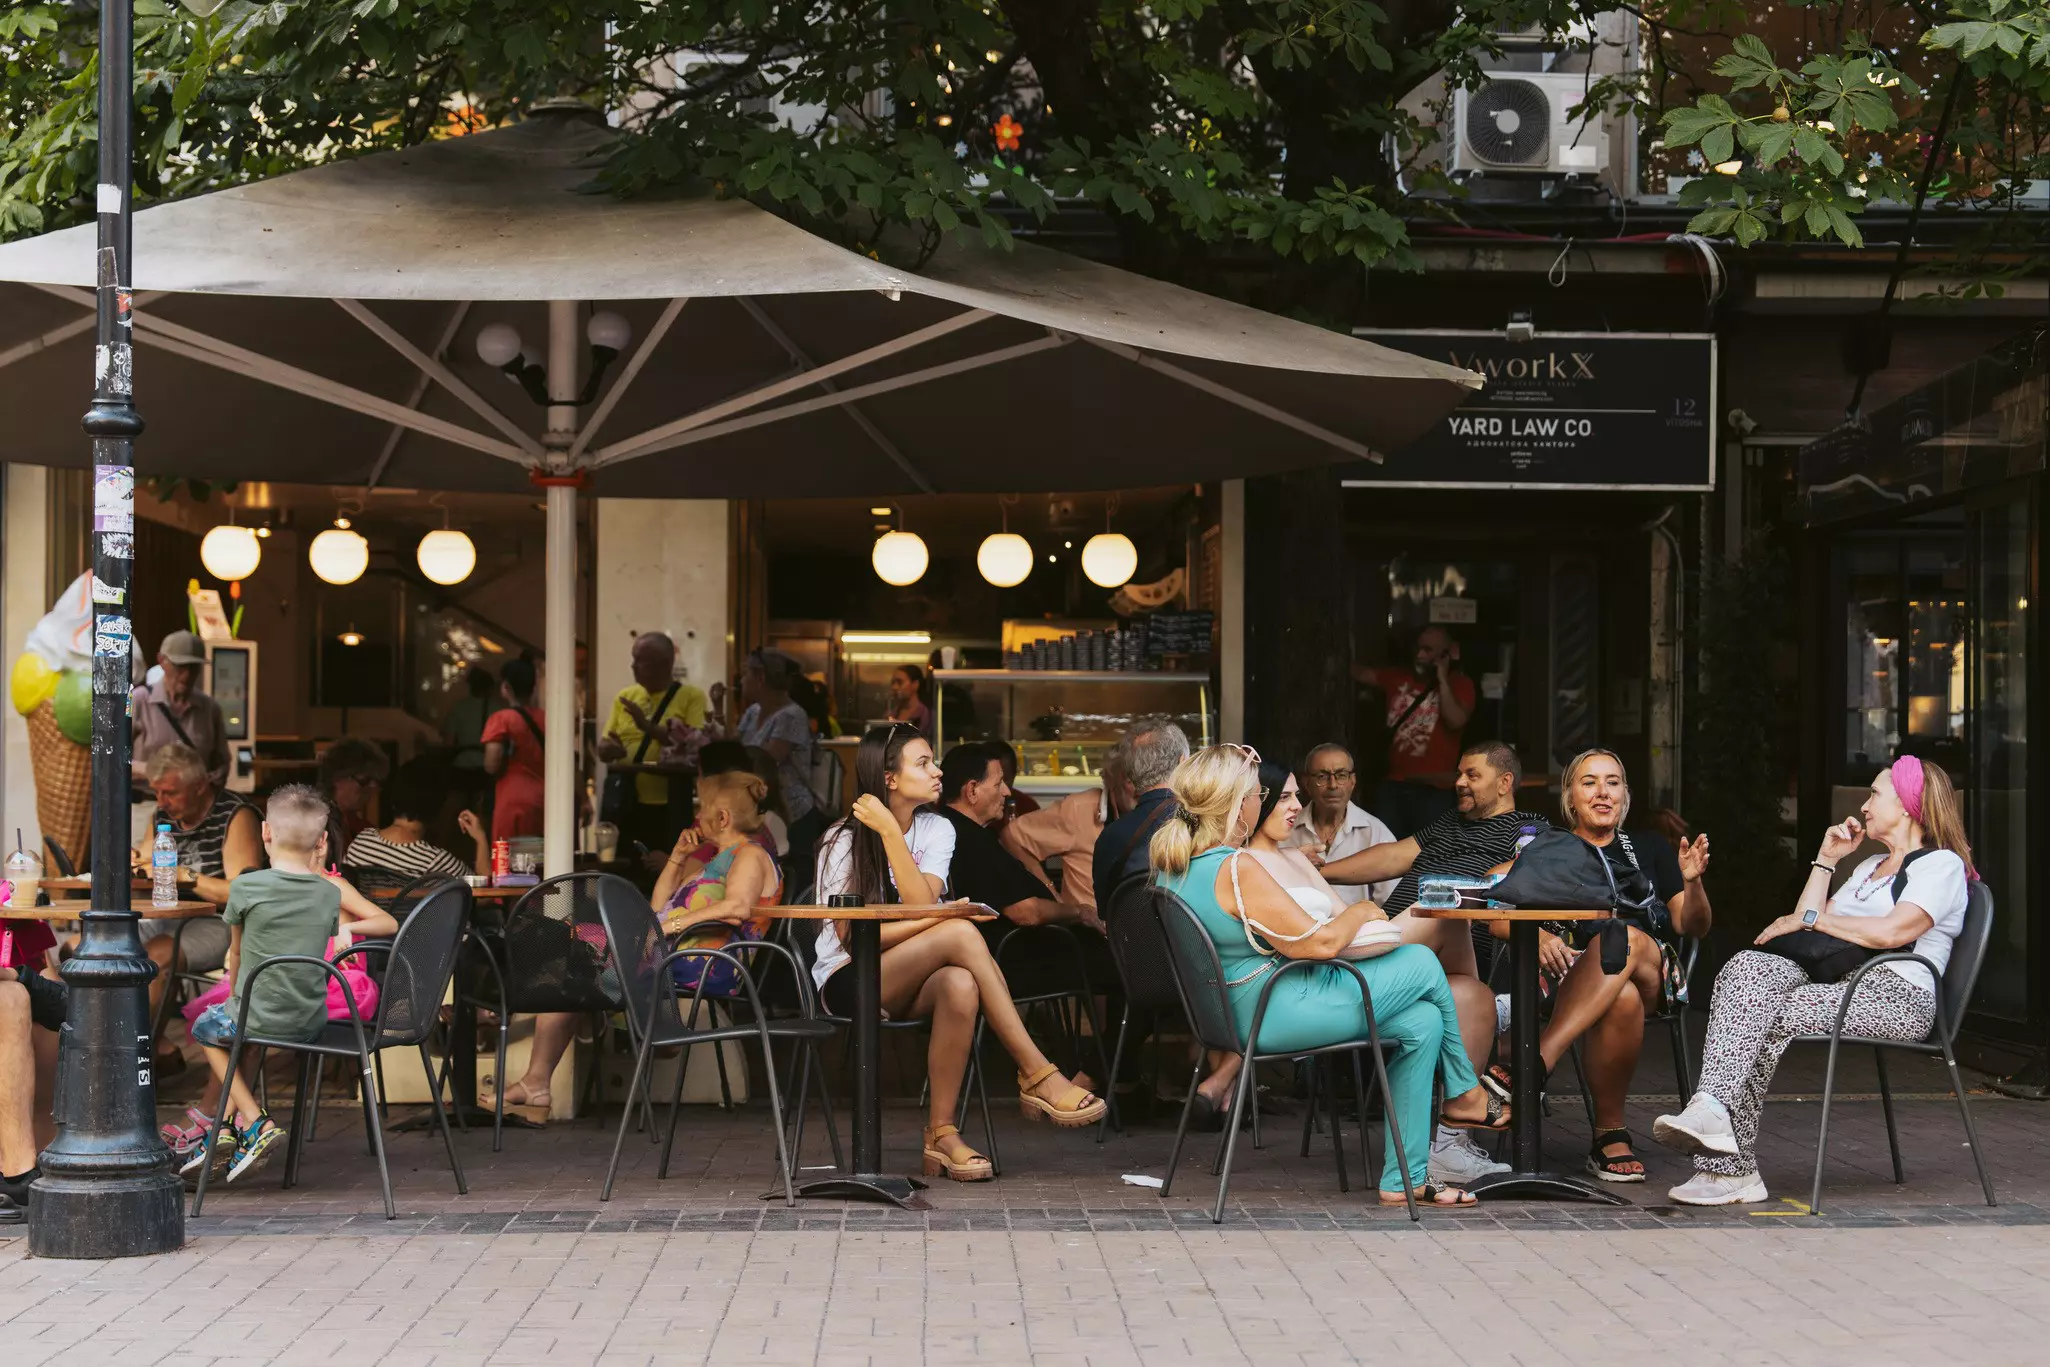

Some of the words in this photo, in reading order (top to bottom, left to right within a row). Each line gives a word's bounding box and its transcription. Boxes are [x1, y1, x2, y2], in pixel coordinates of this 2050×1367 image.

[1448, 350, 1596, 380] VworkX
[1672, 397, 1696, 416] 12
[1448, 417, 1503, 436] YARD
[1511, 418, 1559, 437] LAW
